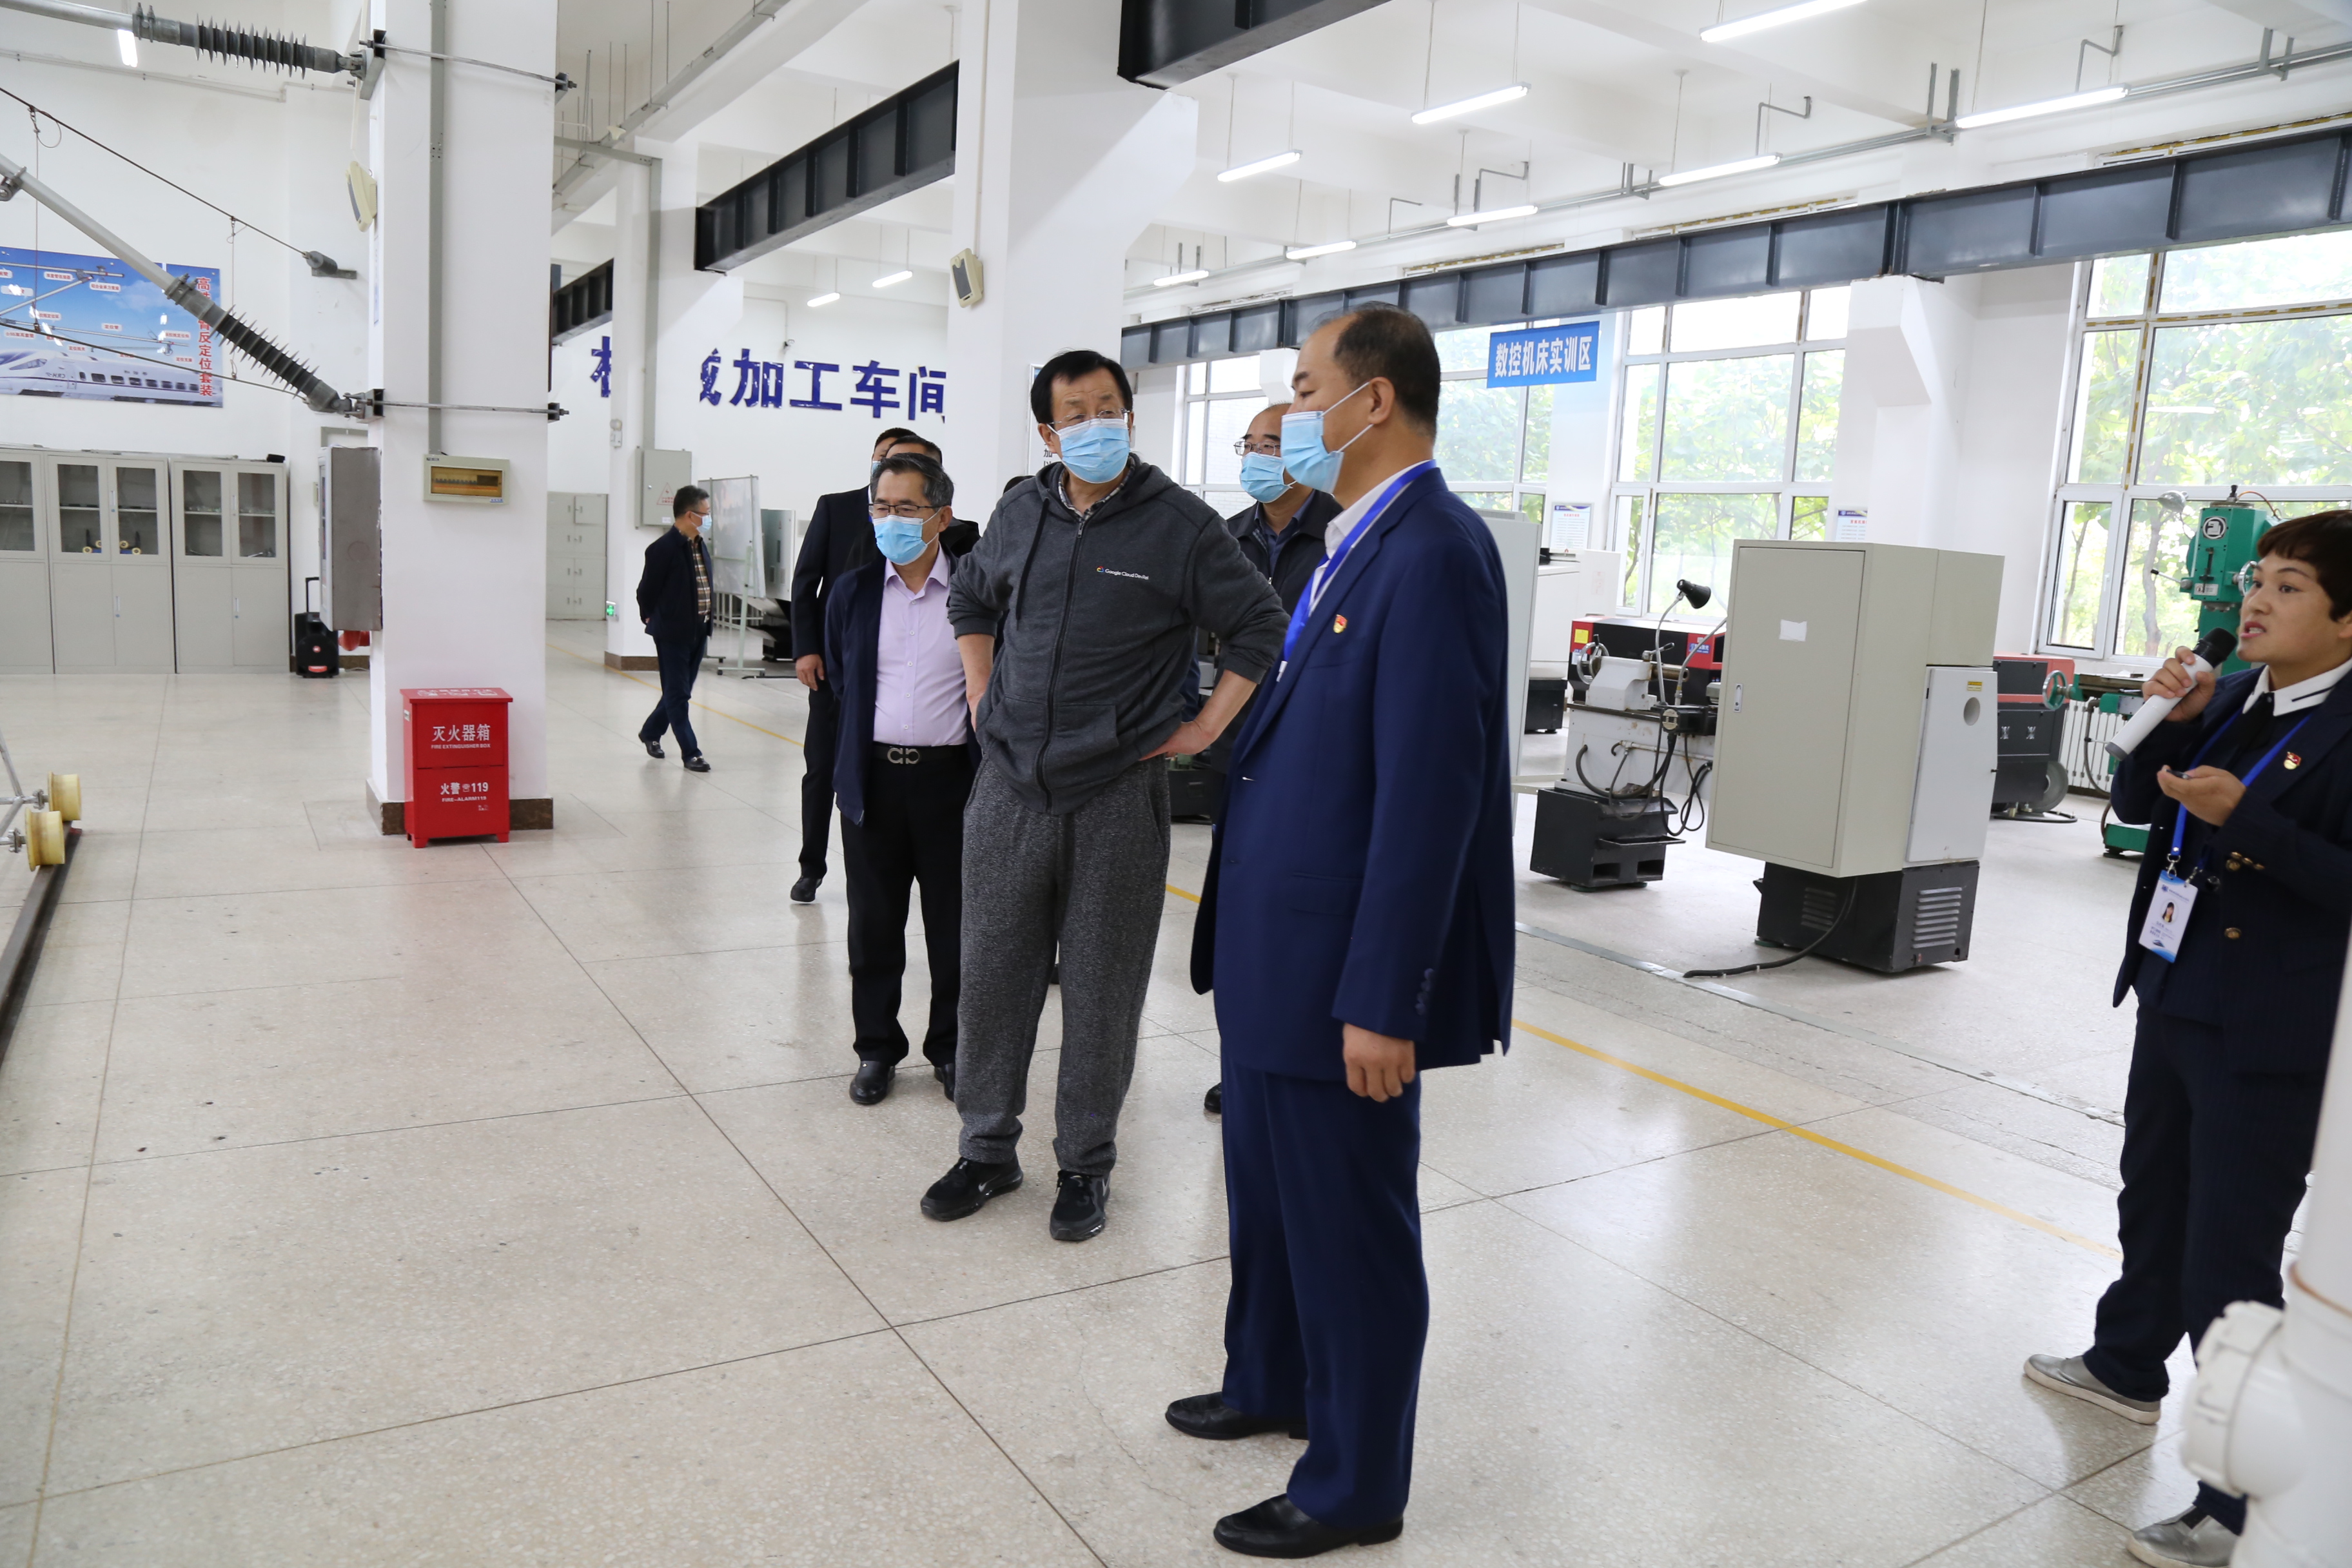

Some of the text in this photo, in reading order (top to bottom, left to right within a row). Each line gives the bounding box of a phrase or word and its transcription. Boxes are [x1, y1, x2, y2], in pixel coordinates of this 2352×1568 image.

[197, 277, 213, 397] 高臂反定位套装
[1494, 336, 1592, 378] 数控机床实训区
[591, 335, 946, 423] 加工车间
[432, 723, 491, 742] 灭火器箱
[440, 781, 489, 796] 火警 119
